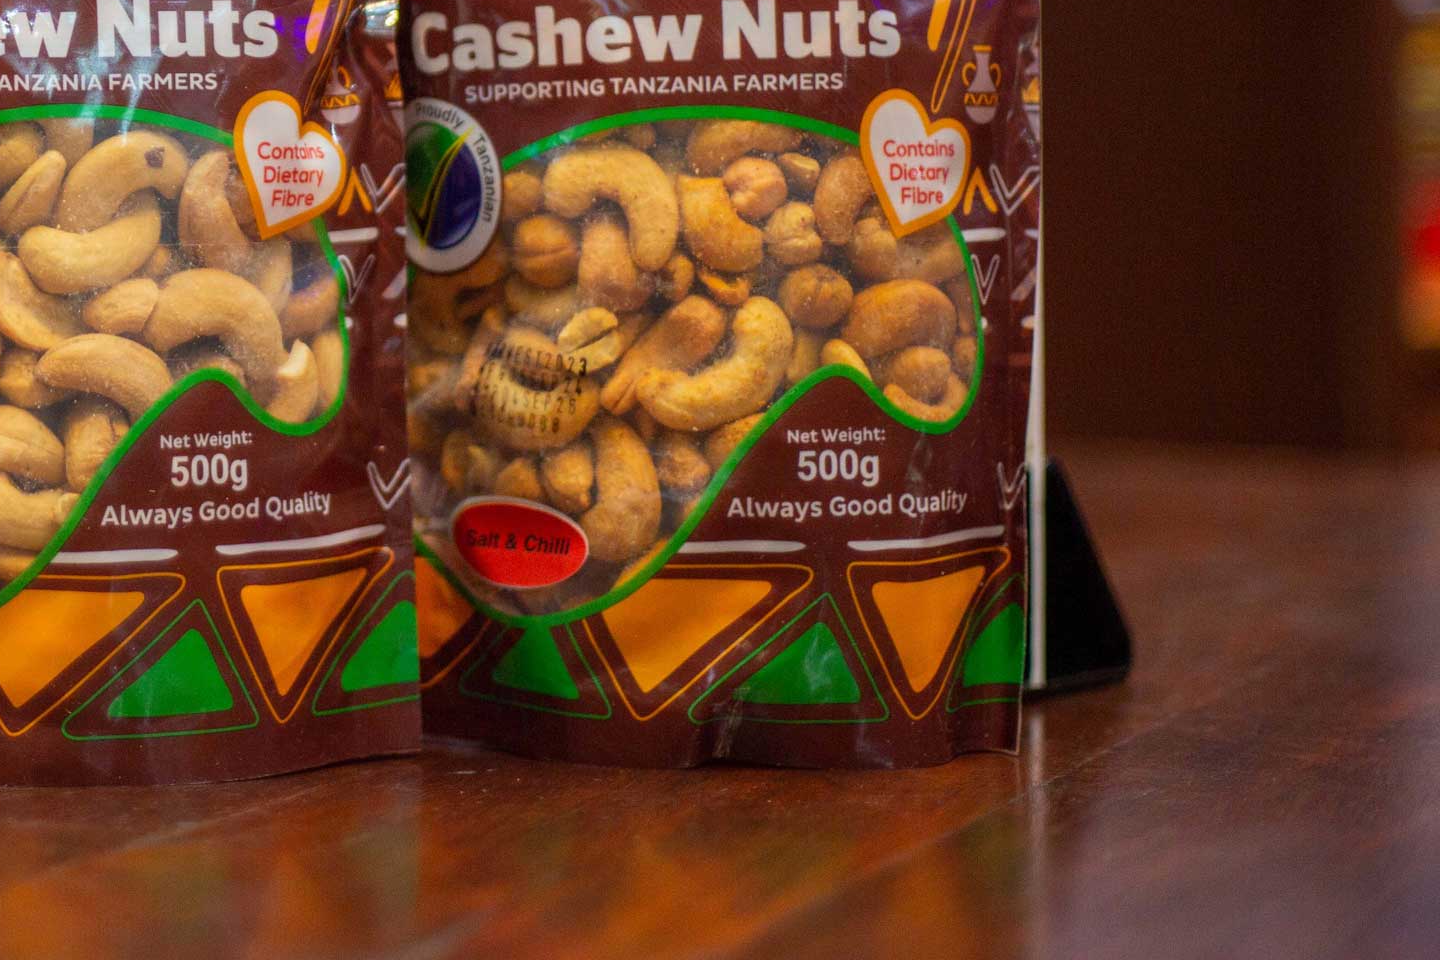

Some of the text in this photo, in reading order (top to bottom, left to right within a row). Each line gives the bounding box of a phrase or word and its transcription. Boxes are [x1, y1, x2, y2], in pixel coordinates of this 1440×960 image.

[411, 5, 702, 74] Cashew
[107, 72, 218, 92] FARMERS
[464, 72, 844, 104] SUPPORTING TANZANIA FARMERS
[257, 141, 325, 162] Contains
[882, 138, 956, 159] Contains
[263, 165, 325, 190] Dietary
[472, 134, 496, 222] Tanzanian
[889, 162, 949, 186] Dietary
[271, 188, 314, 208] Fibre
[900, 185, 944, 206] Fibre
[160, 431, 253, 451] Net Weight:
[786, 426, 886, 446] Net Weight:
[170, 453, 249, 491] 500g
[796, 450, 880, 487] 500g
[101, 490, 332, 529] Always Good Quality
[727, 489, 967, 521] Always Good Quality
[465, 528, 500, 549] Salt
[505, 532, 517, 550] &
